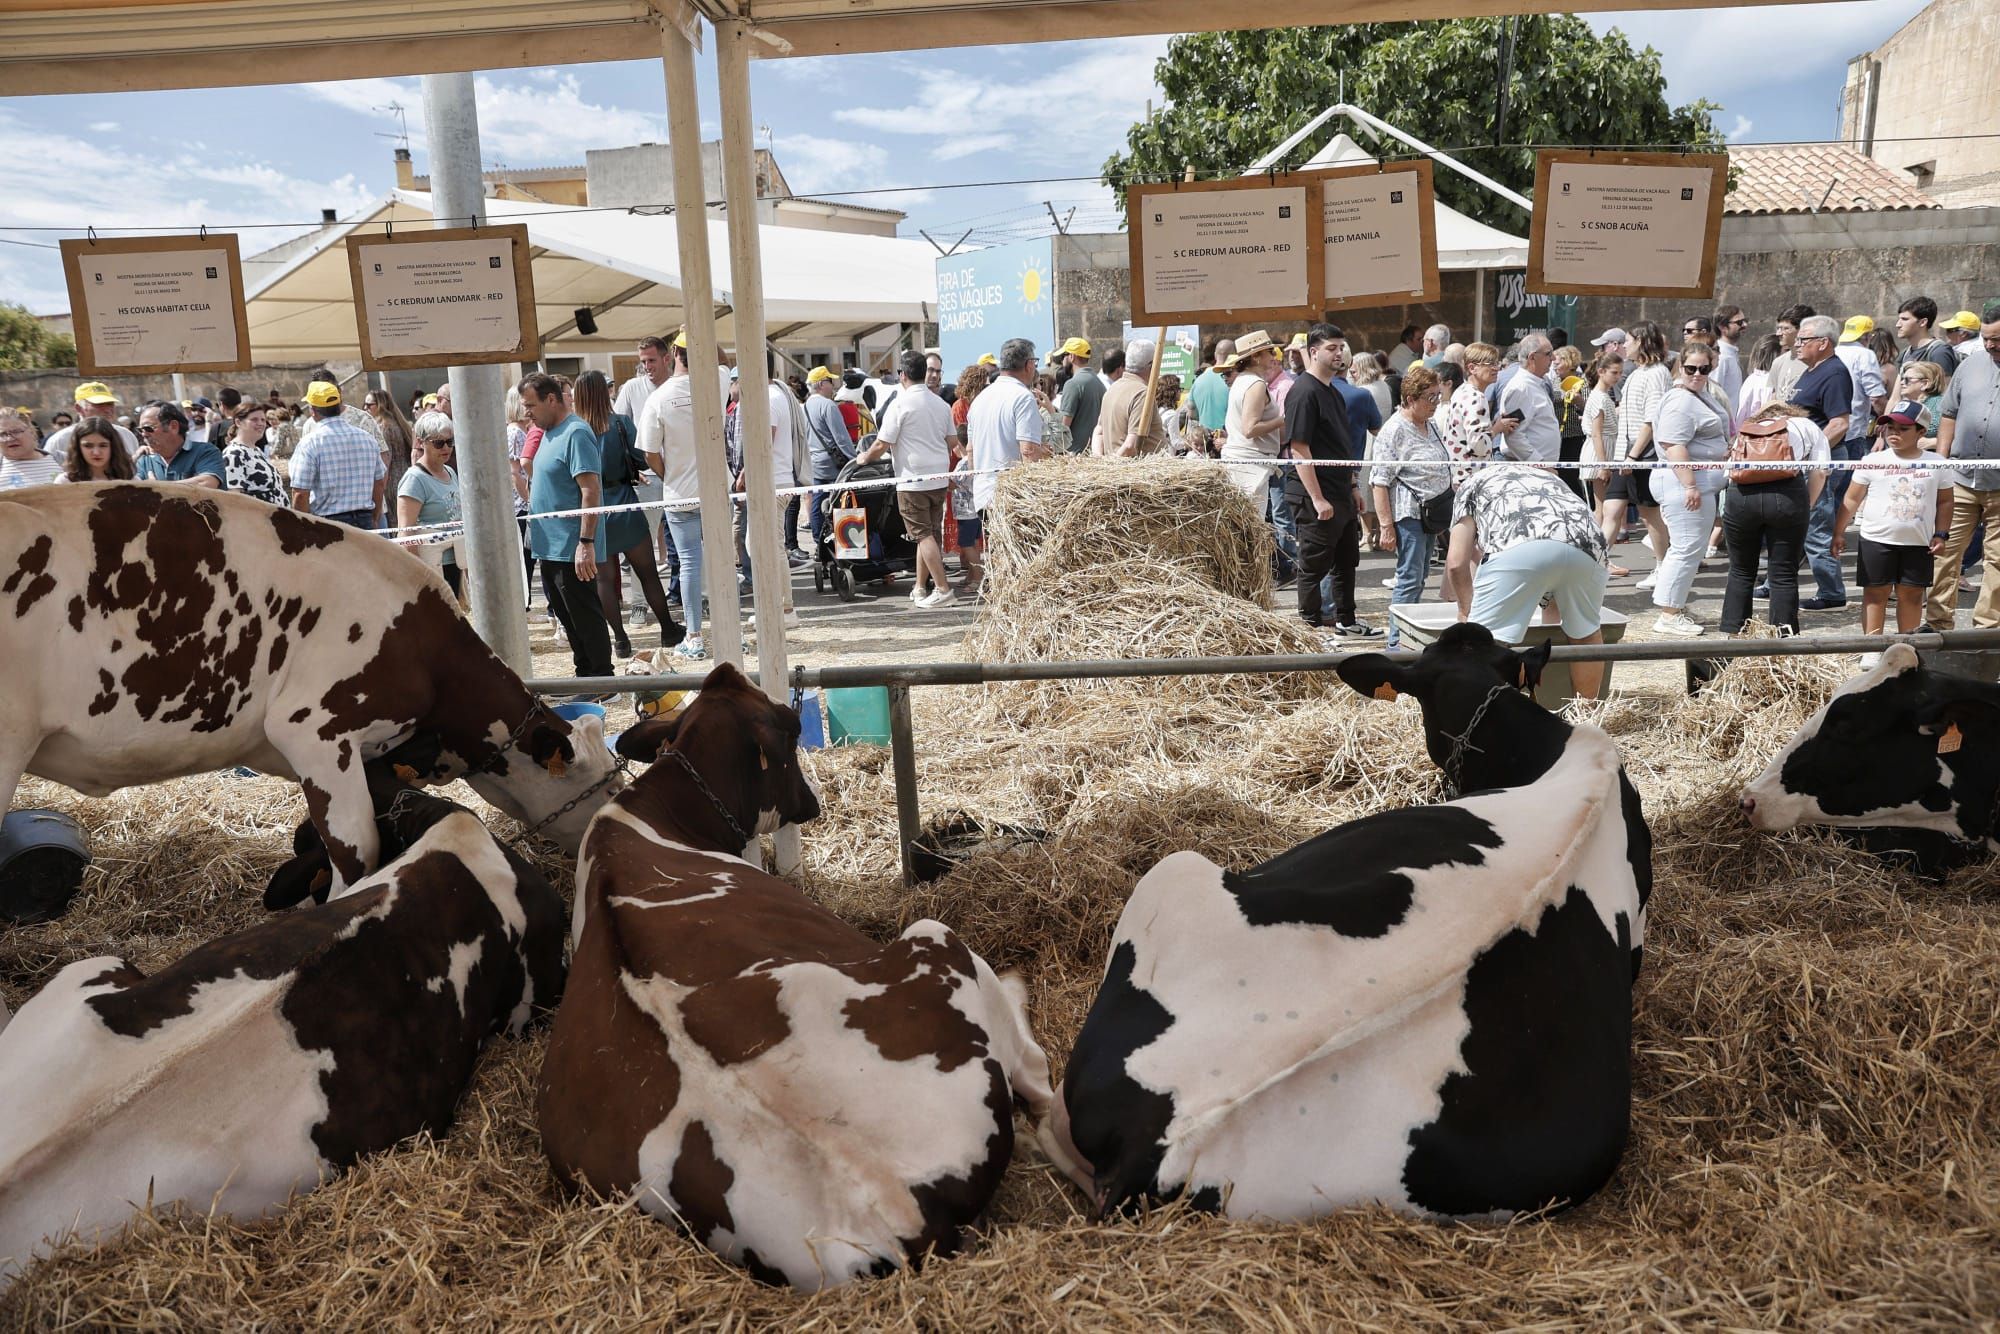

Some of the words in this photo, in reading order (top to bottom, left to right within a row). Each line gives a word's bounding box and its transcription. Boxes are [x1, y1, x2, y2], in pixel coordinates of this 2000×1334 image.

[1581, 221, 1586, 229] S
[1588, 221, 1594, 229] C
[1595, 222, 1618, 230] SNOB
[1620, 221, 1649, 231] ACUÑA
[1346, 231, 1381, 242] MANILA
[1173, 250, 1179, 258] S
[1181, 249, 1187, 257] C
[1188, 247, 1227, 257] REDRUM
[1228, 245, 1266, 255] AURORA
[1273, 243, 1291, 252] RED
[939, 271, 959, 291] FIRA
[961, 267, 976, 289] DE
[393, 298, 399, 306] C
[400, 296, 435, 306] REDRUM
[436, 294, 481, 304] LANDMARK
[487, 292, 503, 301] RED
[939, 292, 958, 312] SES
[959, 285, 1003, 309] VAQUES
[118, 307, 129, 315] HS
[130, 305, 156, 314] COVAS
[157, 304, 188, 313] HABITAT
[190, 303, 211, 312] CELIA
[940, 309, 984, 332] CAMPOS
